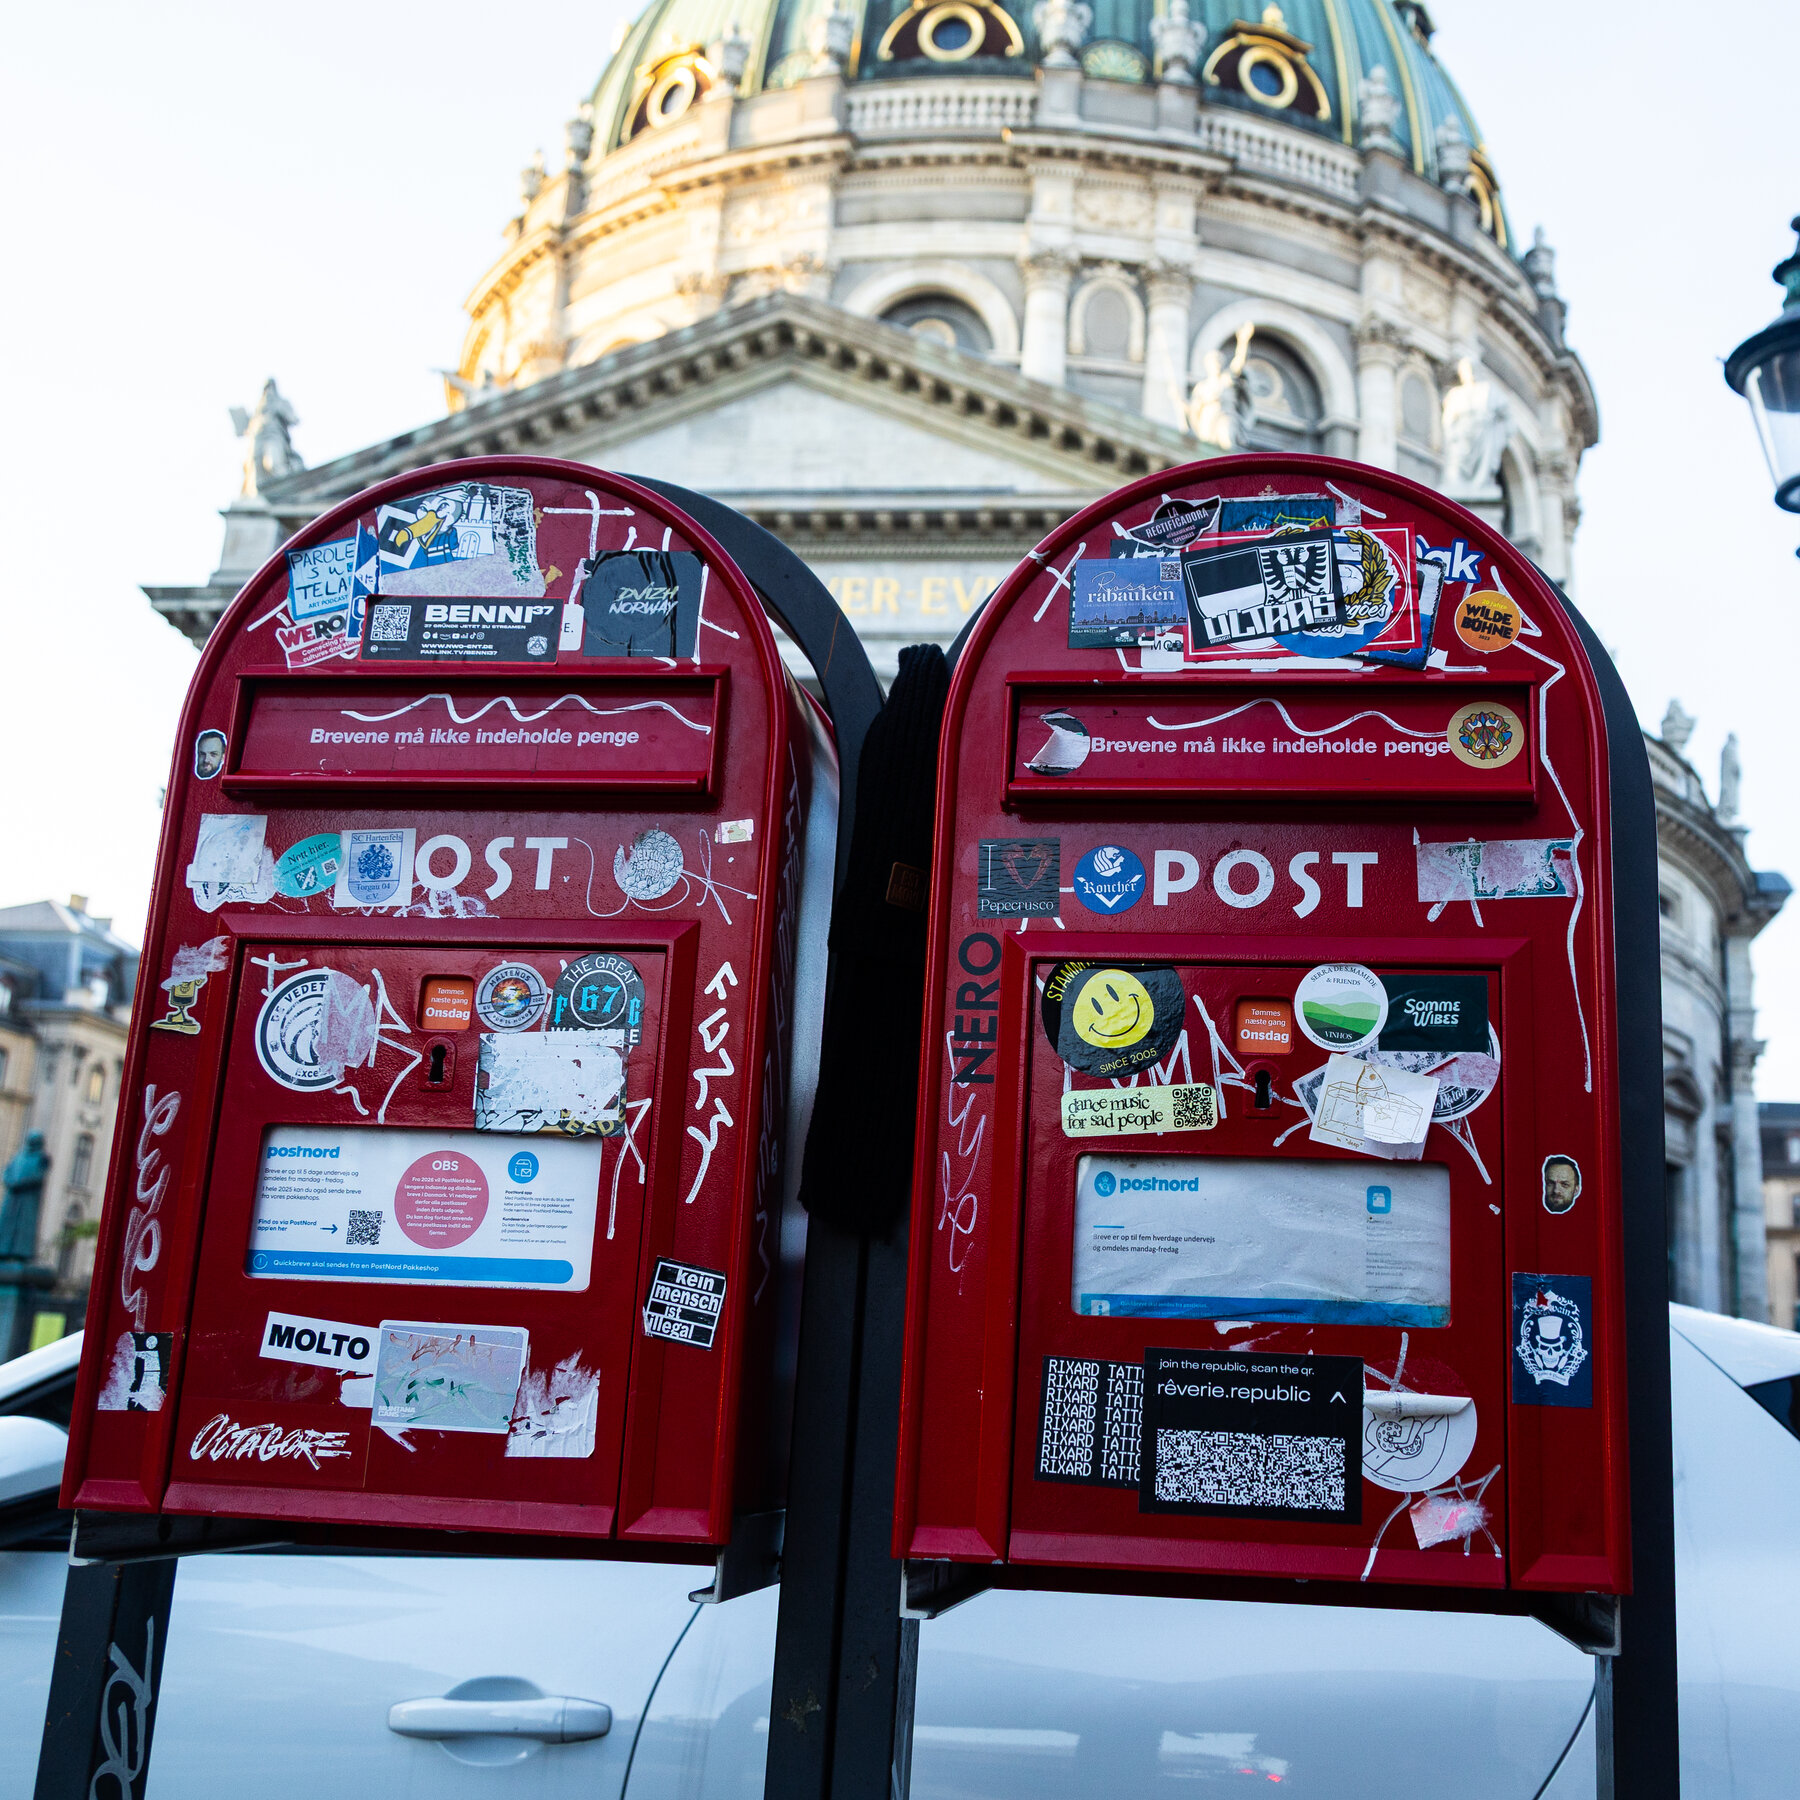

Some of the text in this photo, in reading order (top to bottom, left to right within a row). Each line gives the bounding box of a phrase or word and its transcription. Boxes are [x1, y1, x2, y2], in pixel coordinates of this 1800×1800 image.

[1167, 506, 1179, 519] LA
[1145, 507, 1209, 538] RECTIFICADORA
[290, 542, 355, 569] PAROLE
[296, 577, 348, 600] TELA
[1087, 587, 1175, 603] rabauken
[321, 594, 349, 606] PODCAST
[608, 600, 679, 616] NORWAY
[1203, 594, 1338, 640] ULTRAS
[1465, 603, 1513, 626] WILDE
[302, 638, 339, 656] Connecting
[310, 727, 640, 747] Brevene må ikke indeholde penge
[1090, 736, 1451, 757] Brevene må ikke indeholde penge
[352, 833, 402, 842] SC Hartenfels
[287, 851, 308, 865] Nett
[415, 834, 569, 901] OST
[356, 883, 380, 892] Torgau
[1153, 849, 1379, 919] POST
[563, 955, 639, 984] THE GREAT
[1310, 967, 1333, 983] SERRA
[1332, 977, 1361, 986] FRIENDS
[436, 987, 465, 995] Tømmes
[578, 984, 622, 1014] 67
[430, 996, 469, 1006] næste gang
[950, 932, 1003, 1084] NERO
[425, 1007, 471, 1021] Onsdag
[1251, 1008, 1281, 1017] Tømmes
[1244, 1018, 1286, 1028] næste gang
[1240, 1028, 1290, 1044] Onsdag
[1324, 1030, 1353, 1040] VINHOS
[1099, 1047, 1158, 1074] SINCE 2005
[1067, 1093, 1150, 1114] dance music
[1067, 1109, 1164, 1132] for sad people
[266, 1145, 341, 1159] postnord
[431, 1160, 459, 1172] OBS
[296, 1176, 321, 1184] mandag
[1119, 1176, 1200, 1193] postnord
[1152, 1234, 1183, 1243] hverdage
[1183, 1236, 1216, 1244] undervejs
[1101, 1244, 1130, 1252] omdeles
[1130, 1245, 1179, 1255] mandag-fredag
[273, 1259, 311, 1267] Quickbreve
[311, 1260, 326, 1268] skal
[326, 1261, 349, 1269] sendes
[402, 1264, 440, 1272] Pakkeshop
[654, 1284, 719, 1313] mensch
[664, 1304, 682, 1320] ist
[647, 1314, 695, 1340] illegal
[268, 1323, 371, 1361] MOLTO
[1048, 1359, 1100, 1377] RIXARD
[1158, 1358, 1315, 1377] join the republic, scan the qr.
[1047, 1373, 1099, 1391] RIXARD
[1157, 1378, 1311, 1404] rêverie.republic
[1046, 1387, 1098, 1405] RIXARD
[1045, 1401, 1096, 1419] RIXARD
[1043, 1416, 1095, 1433] RIXARD
[1042, 1430, 1094, 1448] RIXARD
[1041, 1444, 1093, 1462] RIXARD
[1040, 1458, 1092, 1477] RIXARD
